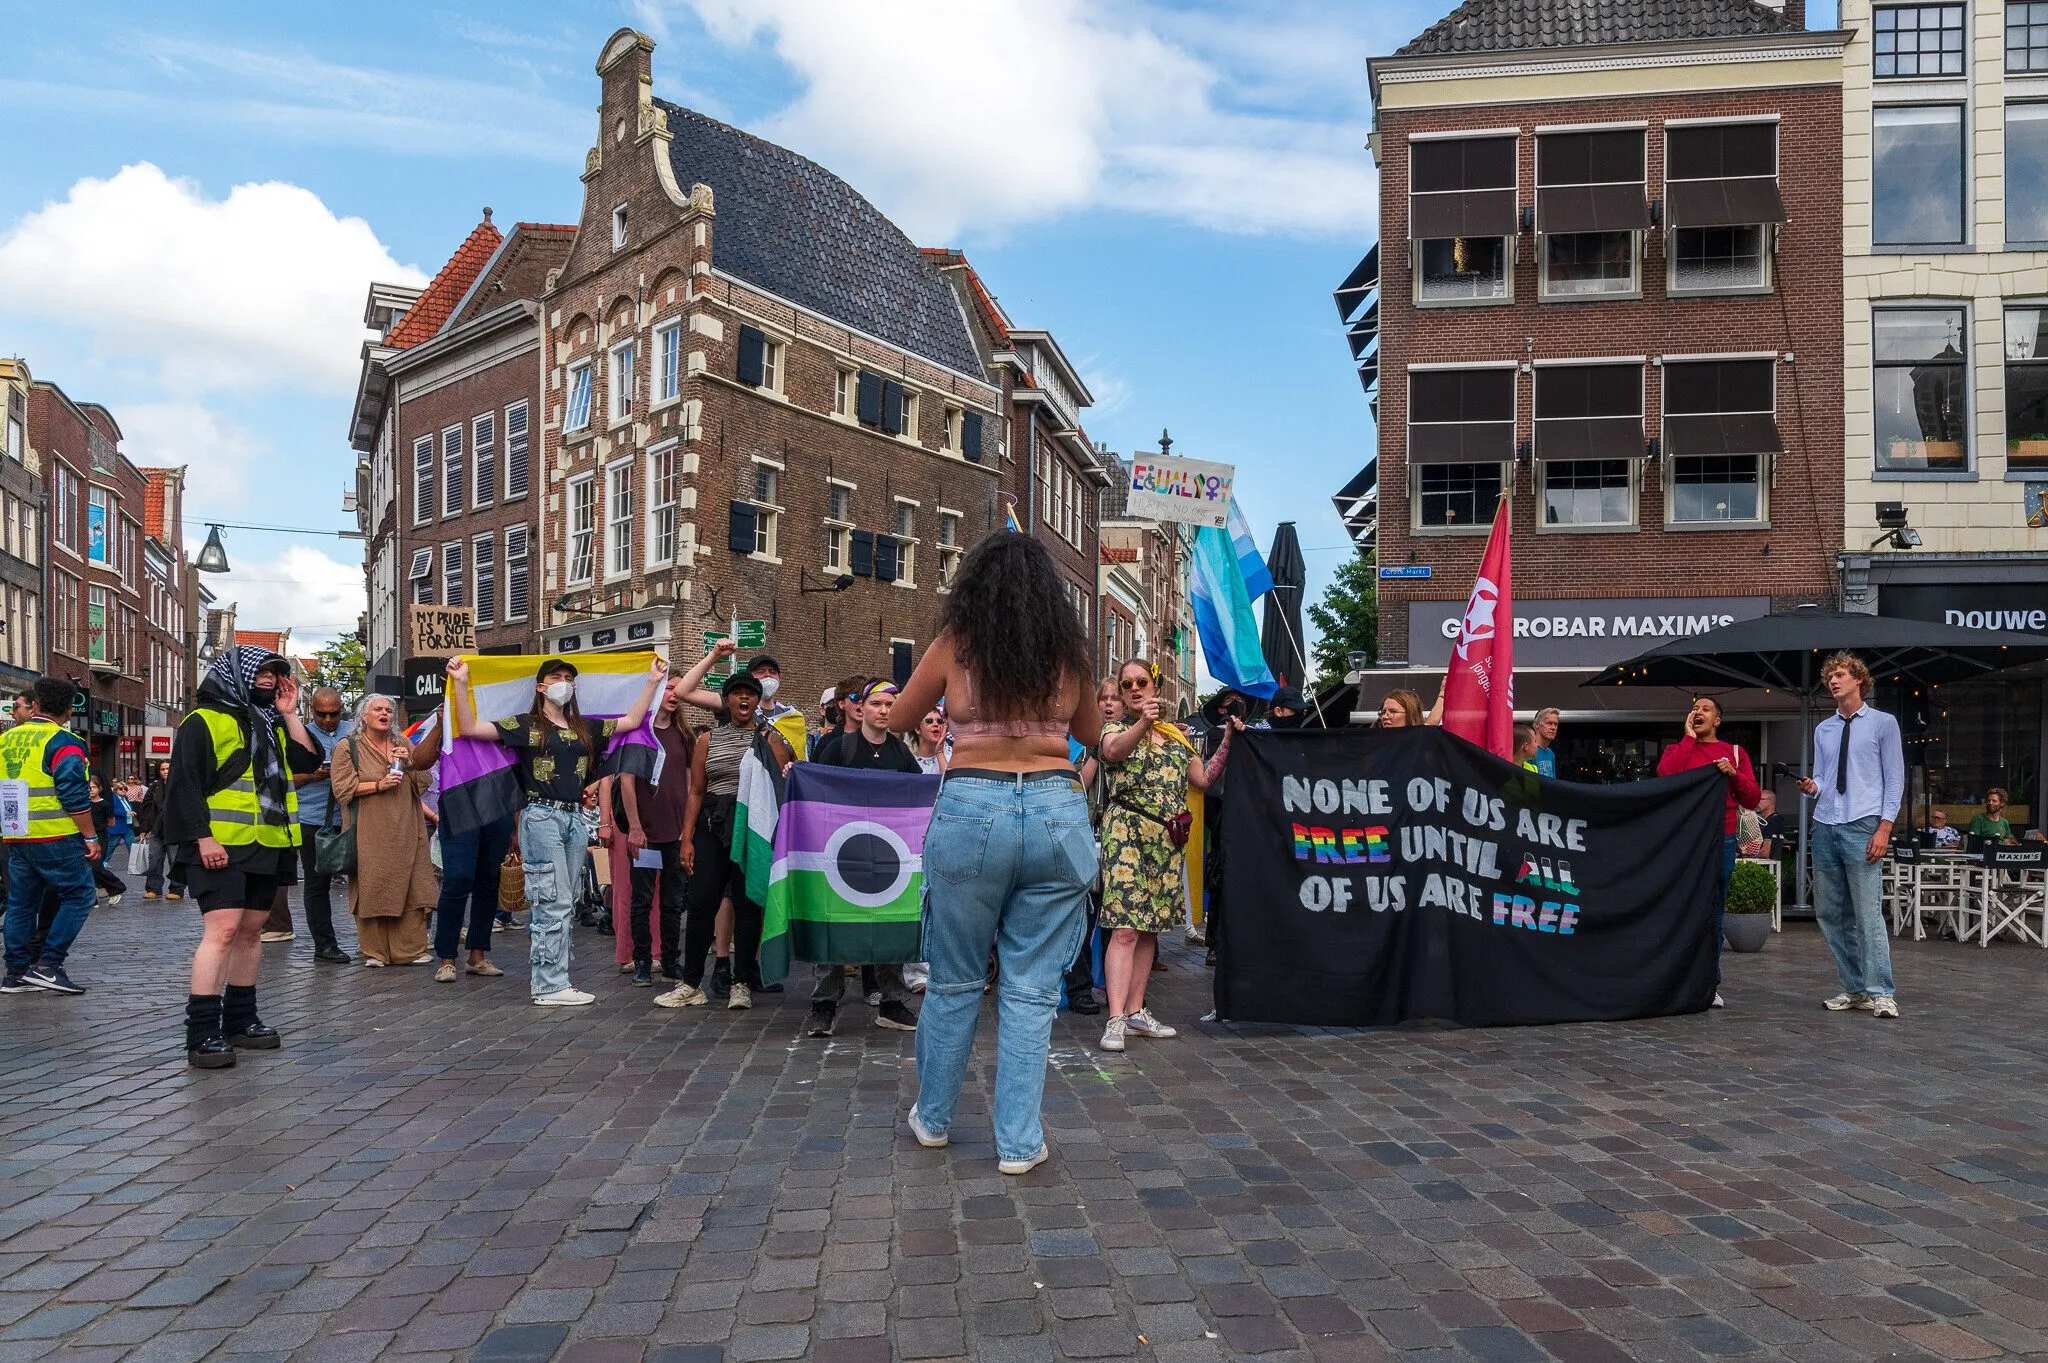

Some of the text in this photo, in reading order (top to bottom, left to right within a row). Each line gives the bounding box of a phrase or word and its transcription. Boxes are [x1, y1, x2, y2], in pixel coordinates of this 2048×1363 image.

[1173, 504, 1188, 514] NO
[416, 611, 470, 625] MY PRIDE
[1441, 617, 1605, 638] GROBAR
[420, 622, 473, 636] IS NOT
[418, 633, 475, 650] FOR SALE
[1283, 775, 1588, 852] NONE OF US ARE
[1292, 822, 1581, 896] FREE UNTIL ALL
[1299, 873, 1581, 935] OF US ARE FREE
